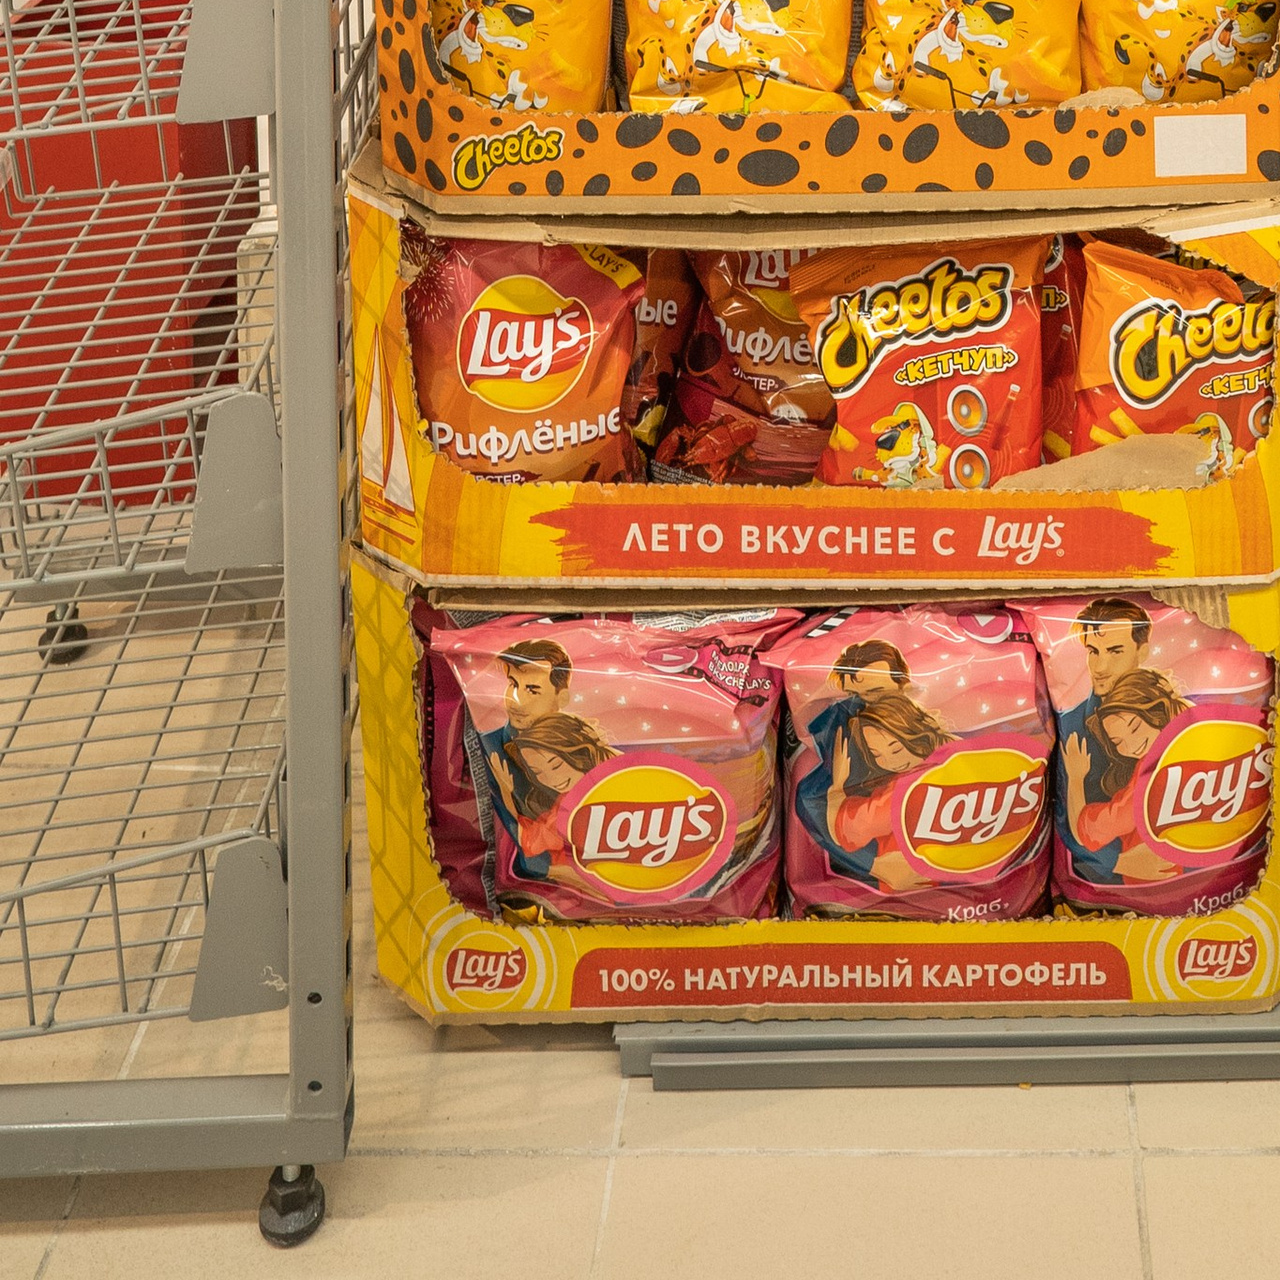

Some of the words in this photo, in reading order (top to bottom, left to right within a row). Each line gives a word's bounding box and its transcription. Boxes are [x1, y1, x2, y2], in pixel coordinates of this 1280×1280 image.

[453, 124, 563, 189] Cheetos
[894, 345, 1018, 387] «КЕТЧУП»
[622, 522, 724, 554] ЛЕТО
[740, 524, 918, 556] ВКУСНЕЕ
[933, 526, 956, 554] С
[978, 514, 1063, 565] Lay's
[581, 796, 713, 868] Lay's
[914, 770, 1041, 845] Lay's
[599, 969, 677, 995] 100%
[683, 957, 911, 992] НАТУРАЛЬНЫЙ
[921, 958, 1108, 988] КАРТОФЕЛЬ
